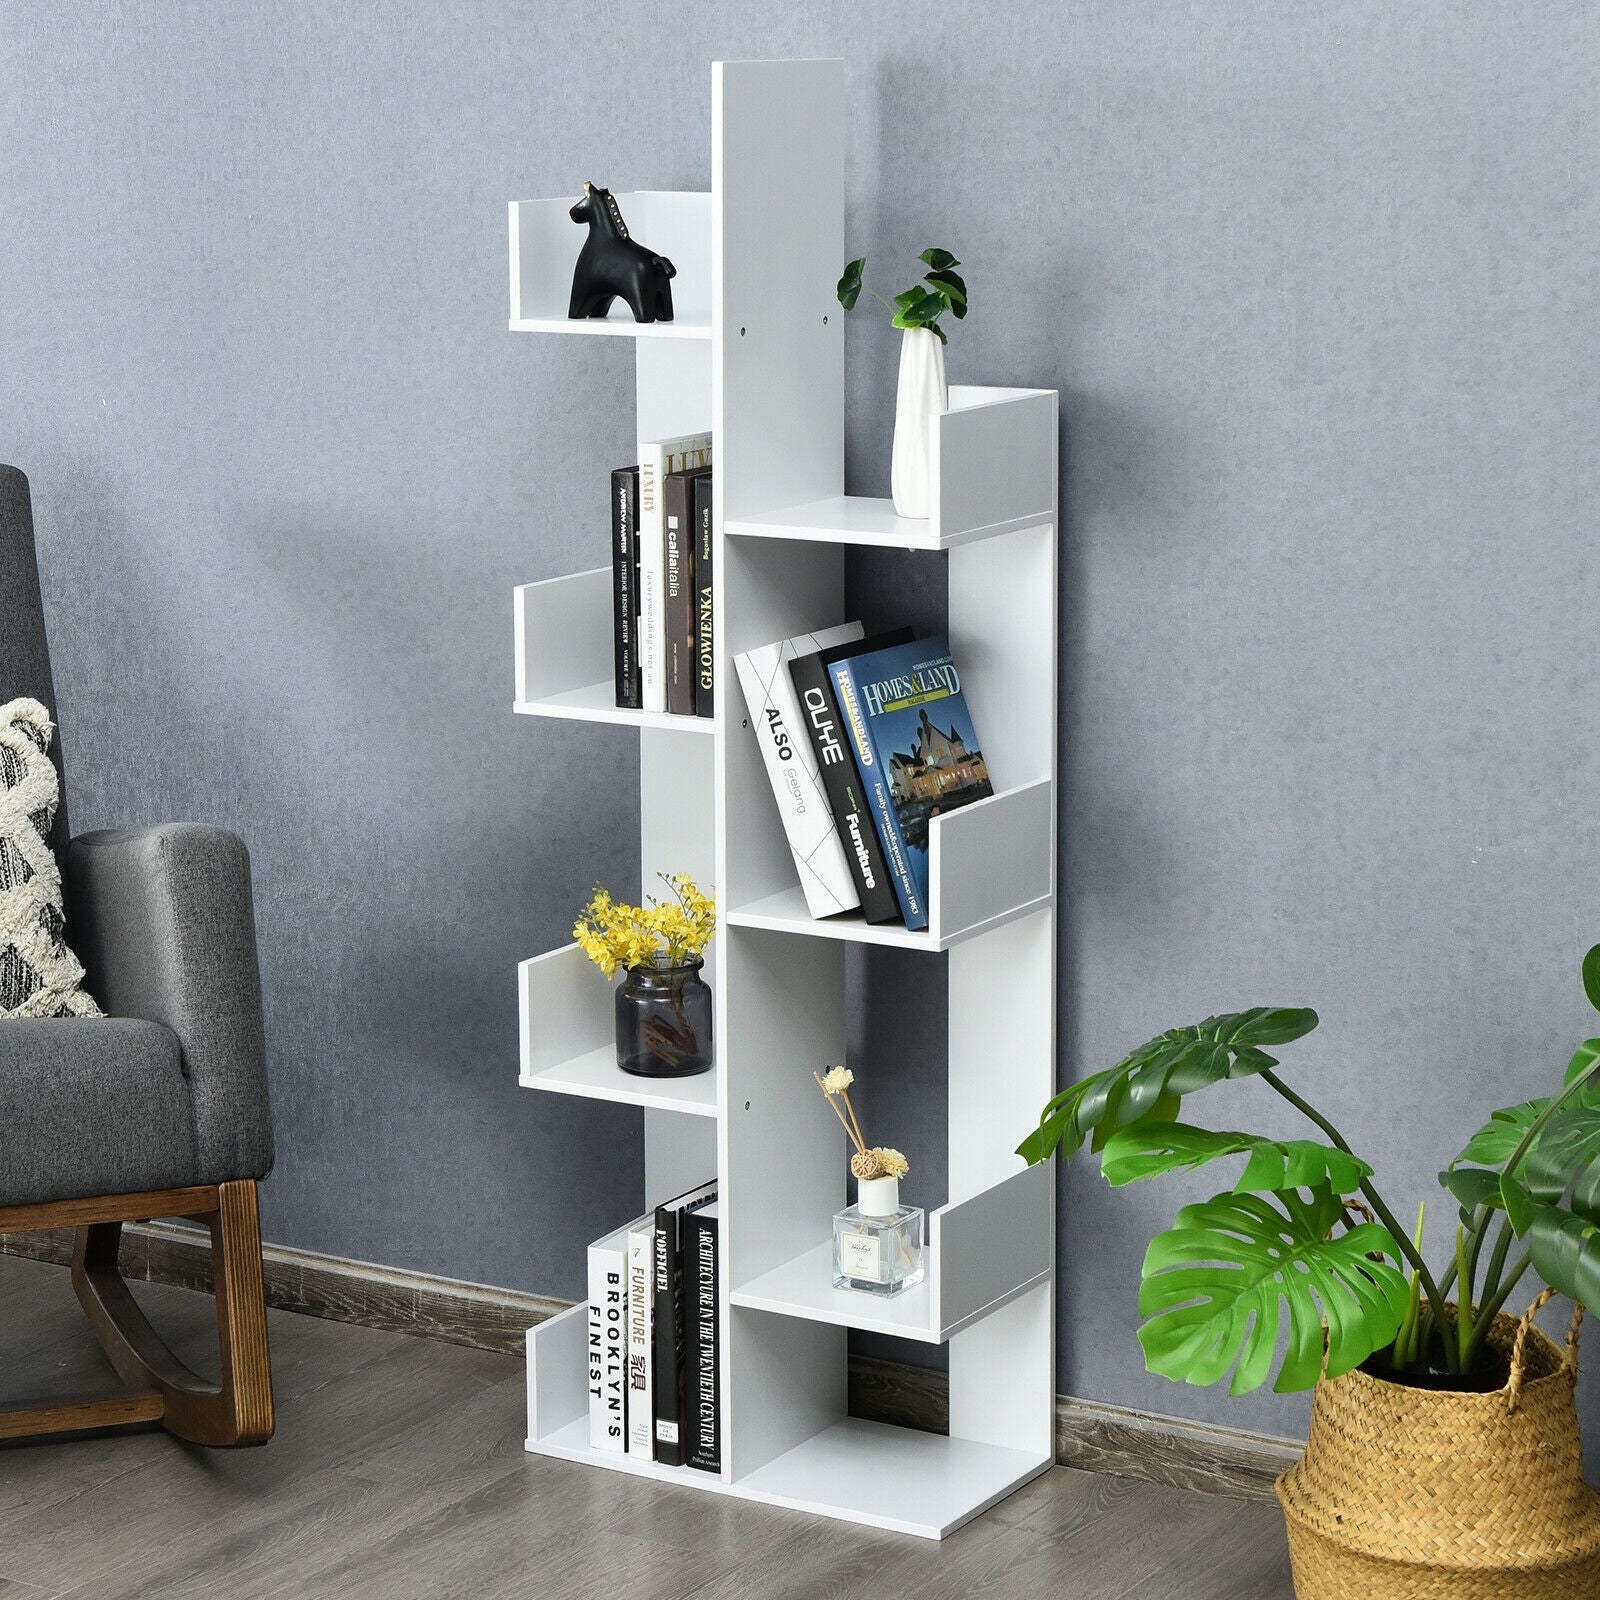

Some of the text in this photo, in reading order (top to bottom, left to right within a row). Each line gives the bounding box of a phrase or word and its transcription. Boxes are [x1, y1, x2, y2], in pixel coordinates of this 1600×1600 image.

[619, 487, 628, 554] ANDREW MARTIN
[643, 463, 654, 512] LUXURY
[668, 531, 680, 597] caliaitalia
[645, 570, 655, 685] luxuryweddings.netau
[765, 708, 793, 761] ALSO
[845, 812, 876, 890] Furniture
[874, 782, 886, 810] Family
[902, 874, 913, 896] since
[908, 896, 920, 916] 1983
[632, 1266, 646, 1345] FURNITURE
[699, 1305, 714, 1319] IN
[699, 1319, 714, 1343] THE
[589, 1305, 602, 1399] FINEST
[607, 1272, 621, 1437] BROOKLYN'S
[630, 1354, 647, 1391] 家具
[700, 1342, 715, 1402] TWENTIETH
[700, 1402, 715, 1451] CENTURY
